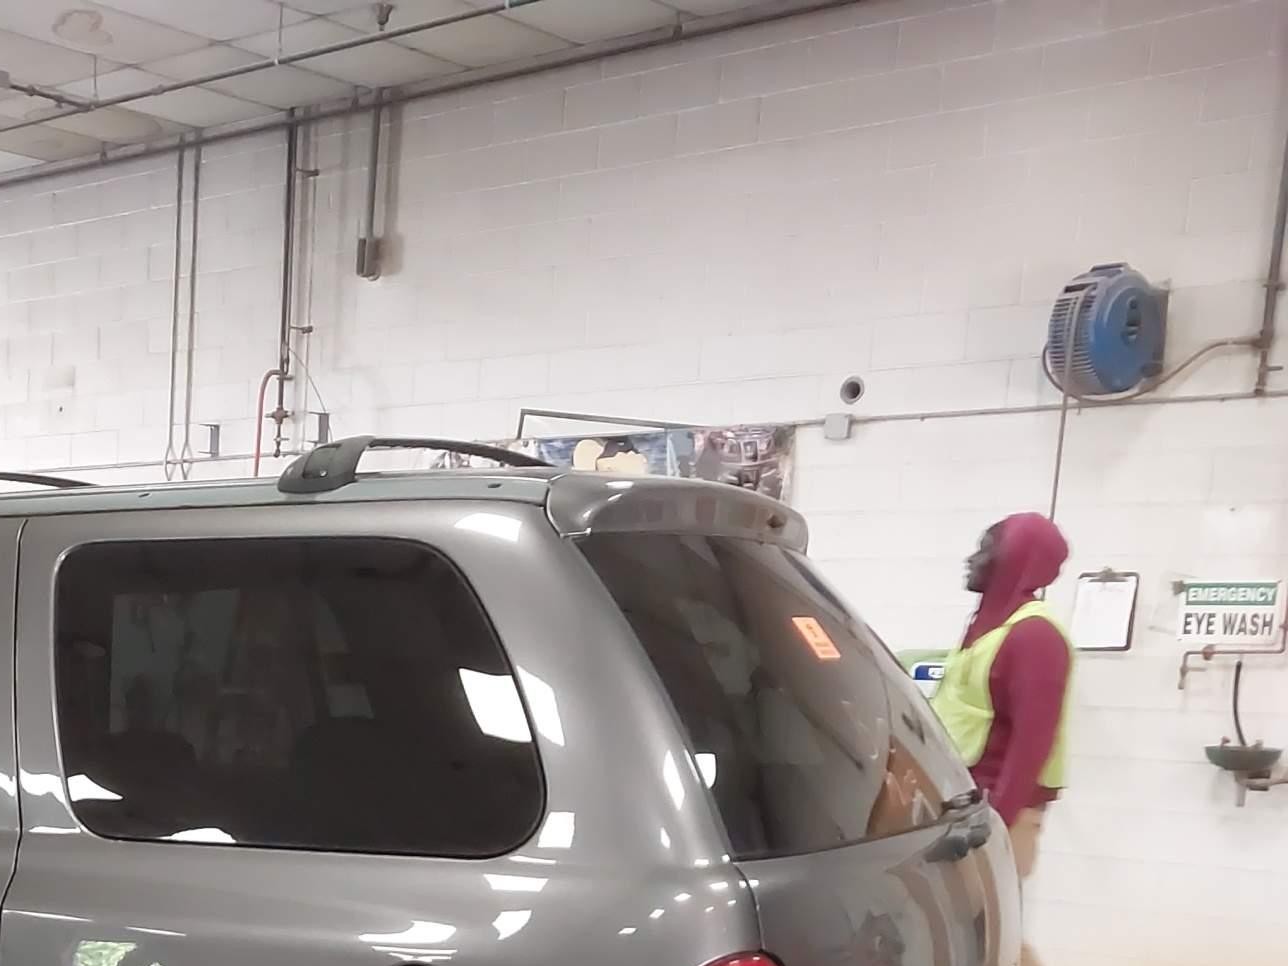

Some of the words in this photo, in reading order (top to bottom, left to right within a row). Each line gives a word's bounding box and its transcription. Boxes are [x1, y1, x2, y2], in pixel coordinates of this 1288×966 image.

[1188, 587, 1276, 602] EMERGENCY
[1182, 612, 1216, 635] EYE
[1223, 612, 1274, 635] WASH
